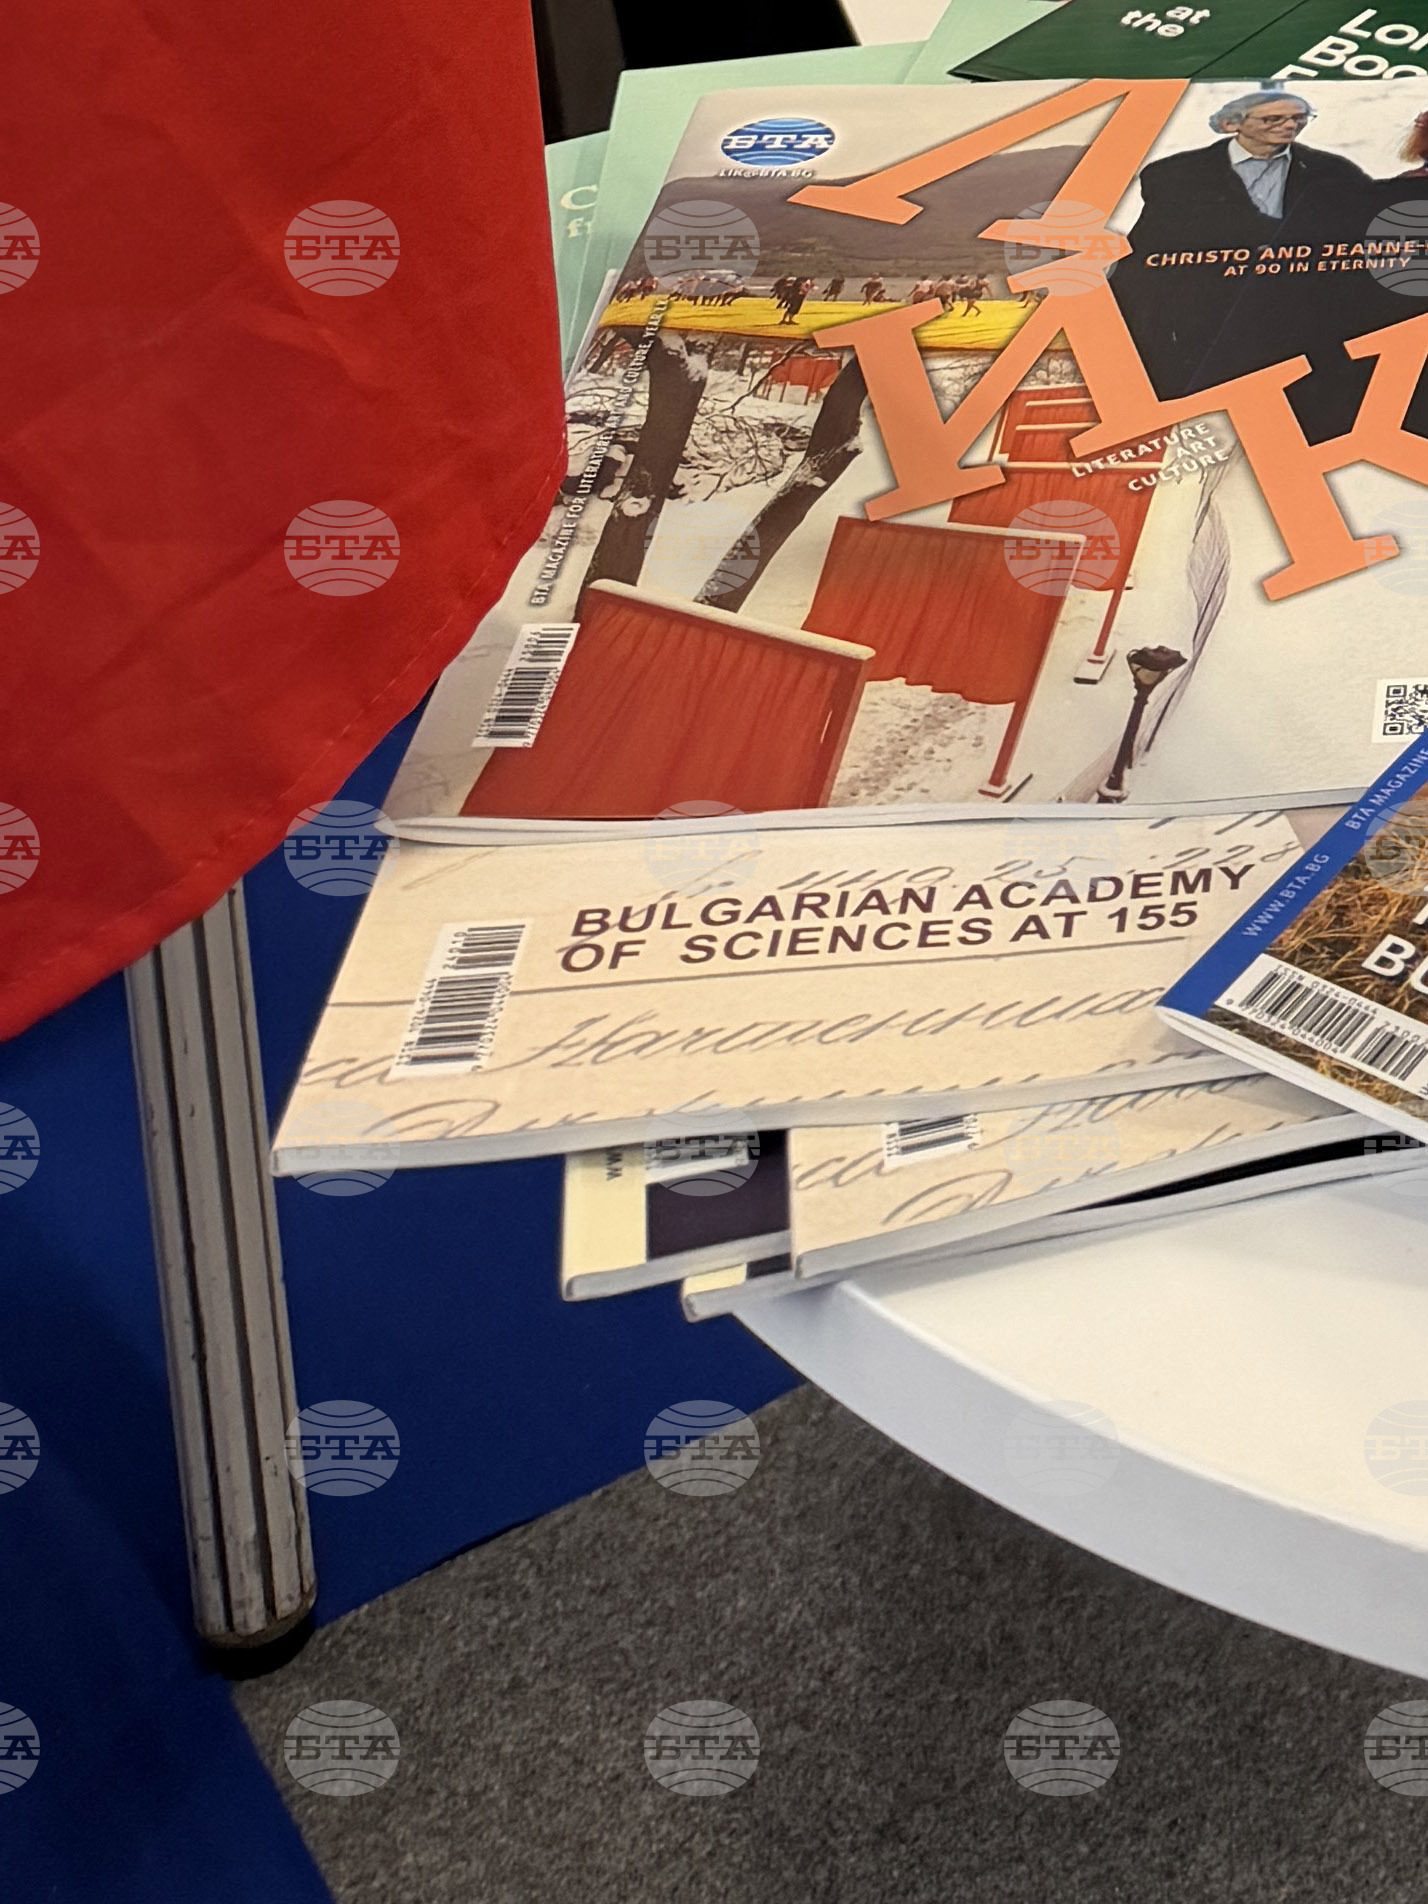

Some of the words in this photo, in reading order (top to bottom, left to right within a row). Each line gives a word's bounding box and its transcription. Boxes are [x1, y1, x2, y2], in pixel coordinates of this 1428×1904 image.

[1120, 8, 1187, 39] the
[1164, 4, 1212, 26] at
[1145, 248, 1251, 268] CHRISTO
[1258, 245, 1313, 261] AND
[1223, 263, 1248, 278] AT
[1254, 262, 1282, 276] 90
[1287, 261, 1310, 274] IN
[1316, 255, 1412, 273] ETERNITY
[1070, 422, 1211, 479] LITERATURE
[1175, 435, 1218, 459] ART
[1127, 448, 1229, 492] CULTURE
[1241, 853, 1331, 938] WWW.BTA.BG
[1344, 805, 1376, 831] BTA
[569, 886, 936, 939] BULGARIAN
[952, 864, 1257, 913] ACADEMY
[559, 938, 648, 974] OF
[679, 914, 994, 965] SCIENCES
[1009, 909, 1090, 944] AT
[1104, 901, 1201, 934] 155
